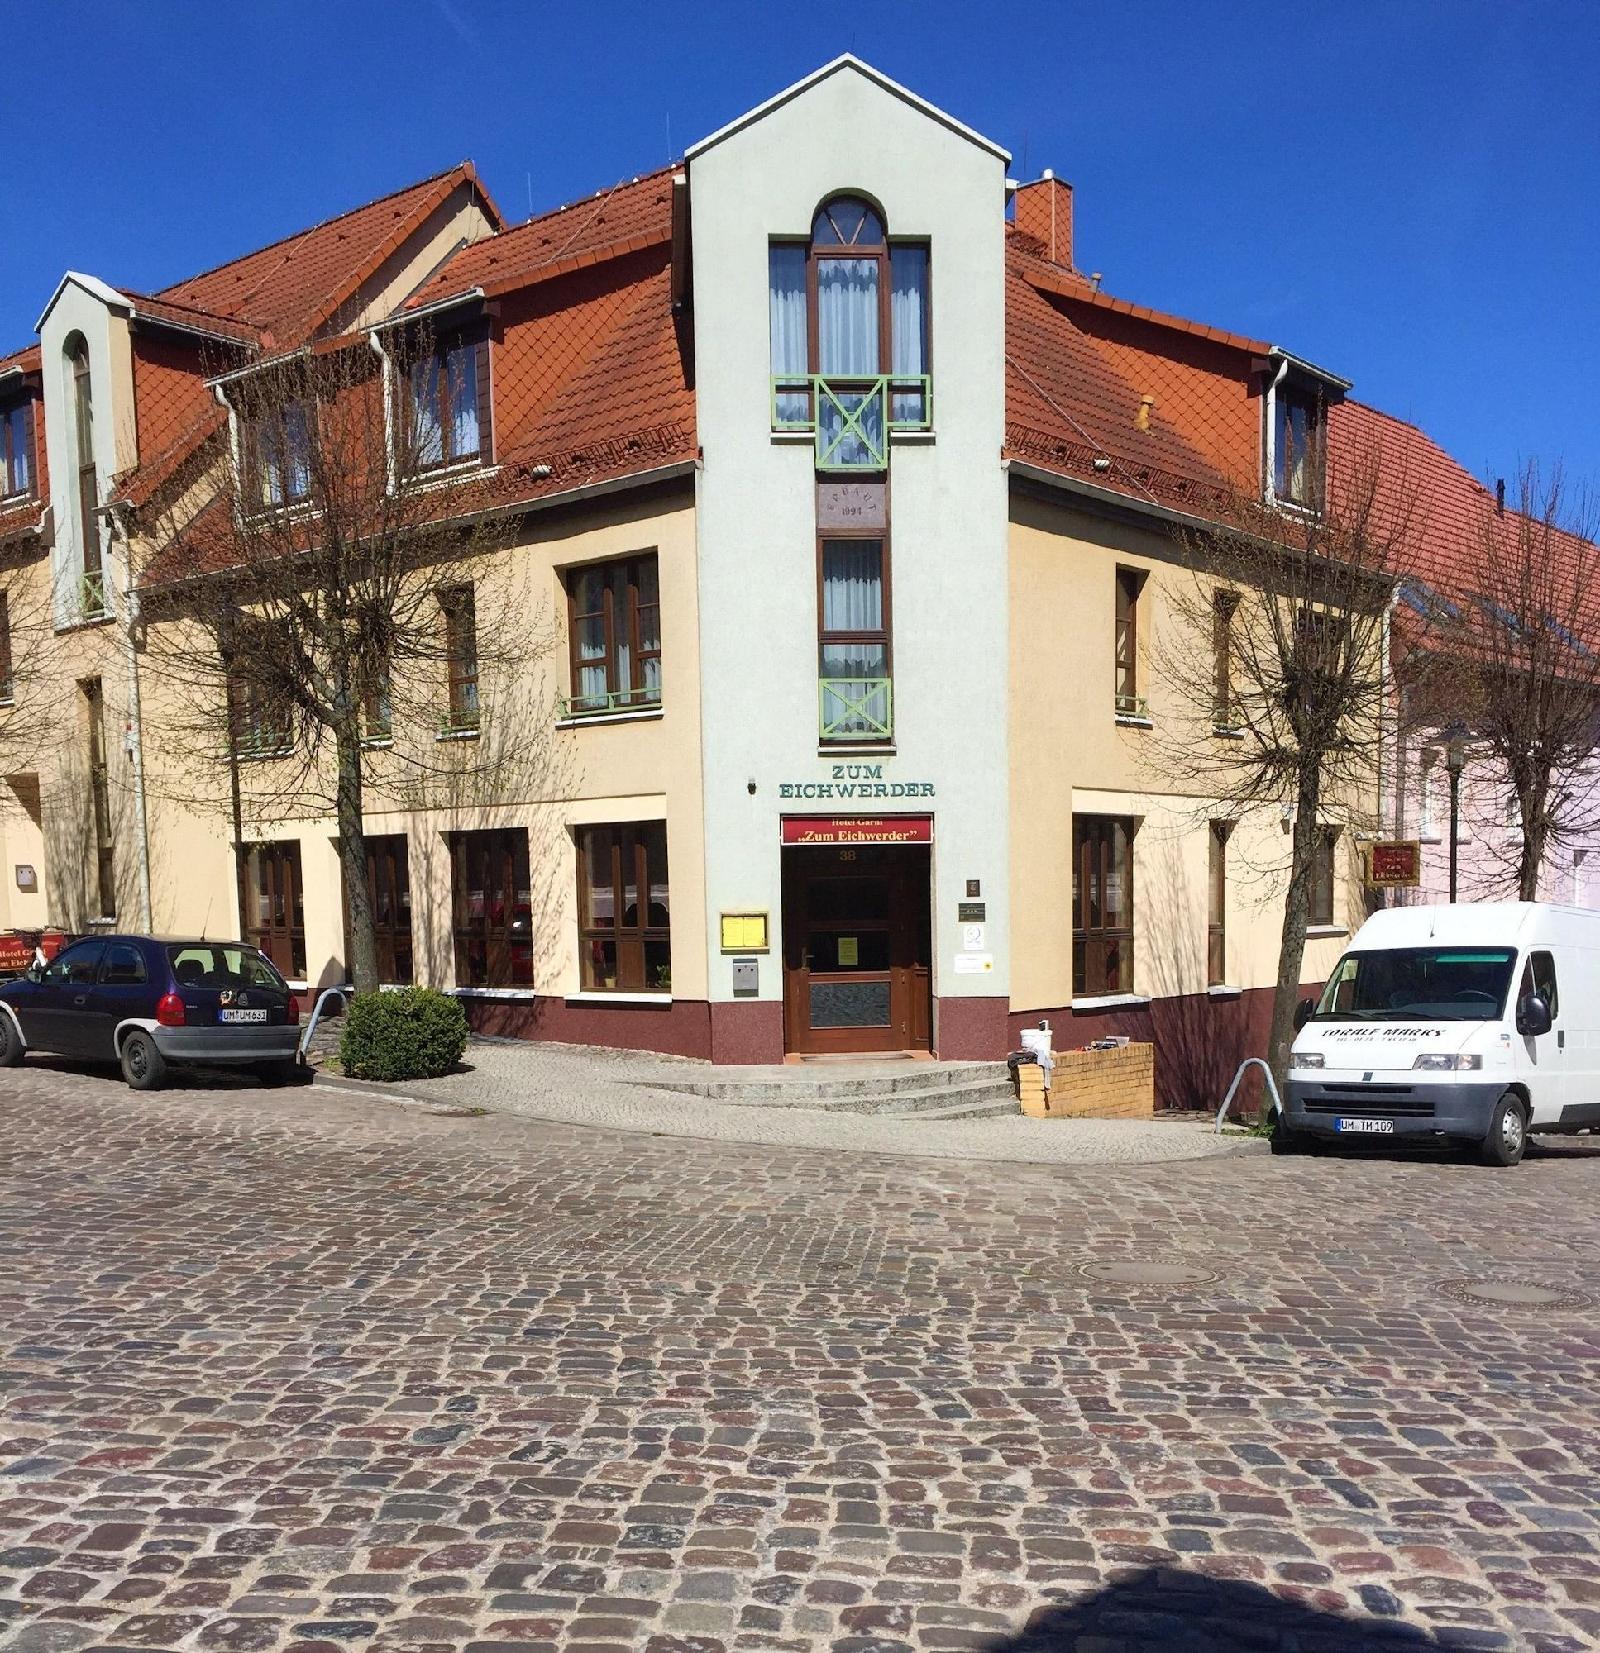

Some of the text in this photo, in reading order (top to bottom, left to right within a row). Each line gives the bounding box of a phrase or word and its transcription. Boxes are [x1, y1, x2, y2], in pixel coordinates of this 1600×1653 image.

[832, 765, 882, 779] ZUM
[779, 783, 935, 798] EICHWERDER
[839, 849, 857, 861] 38
